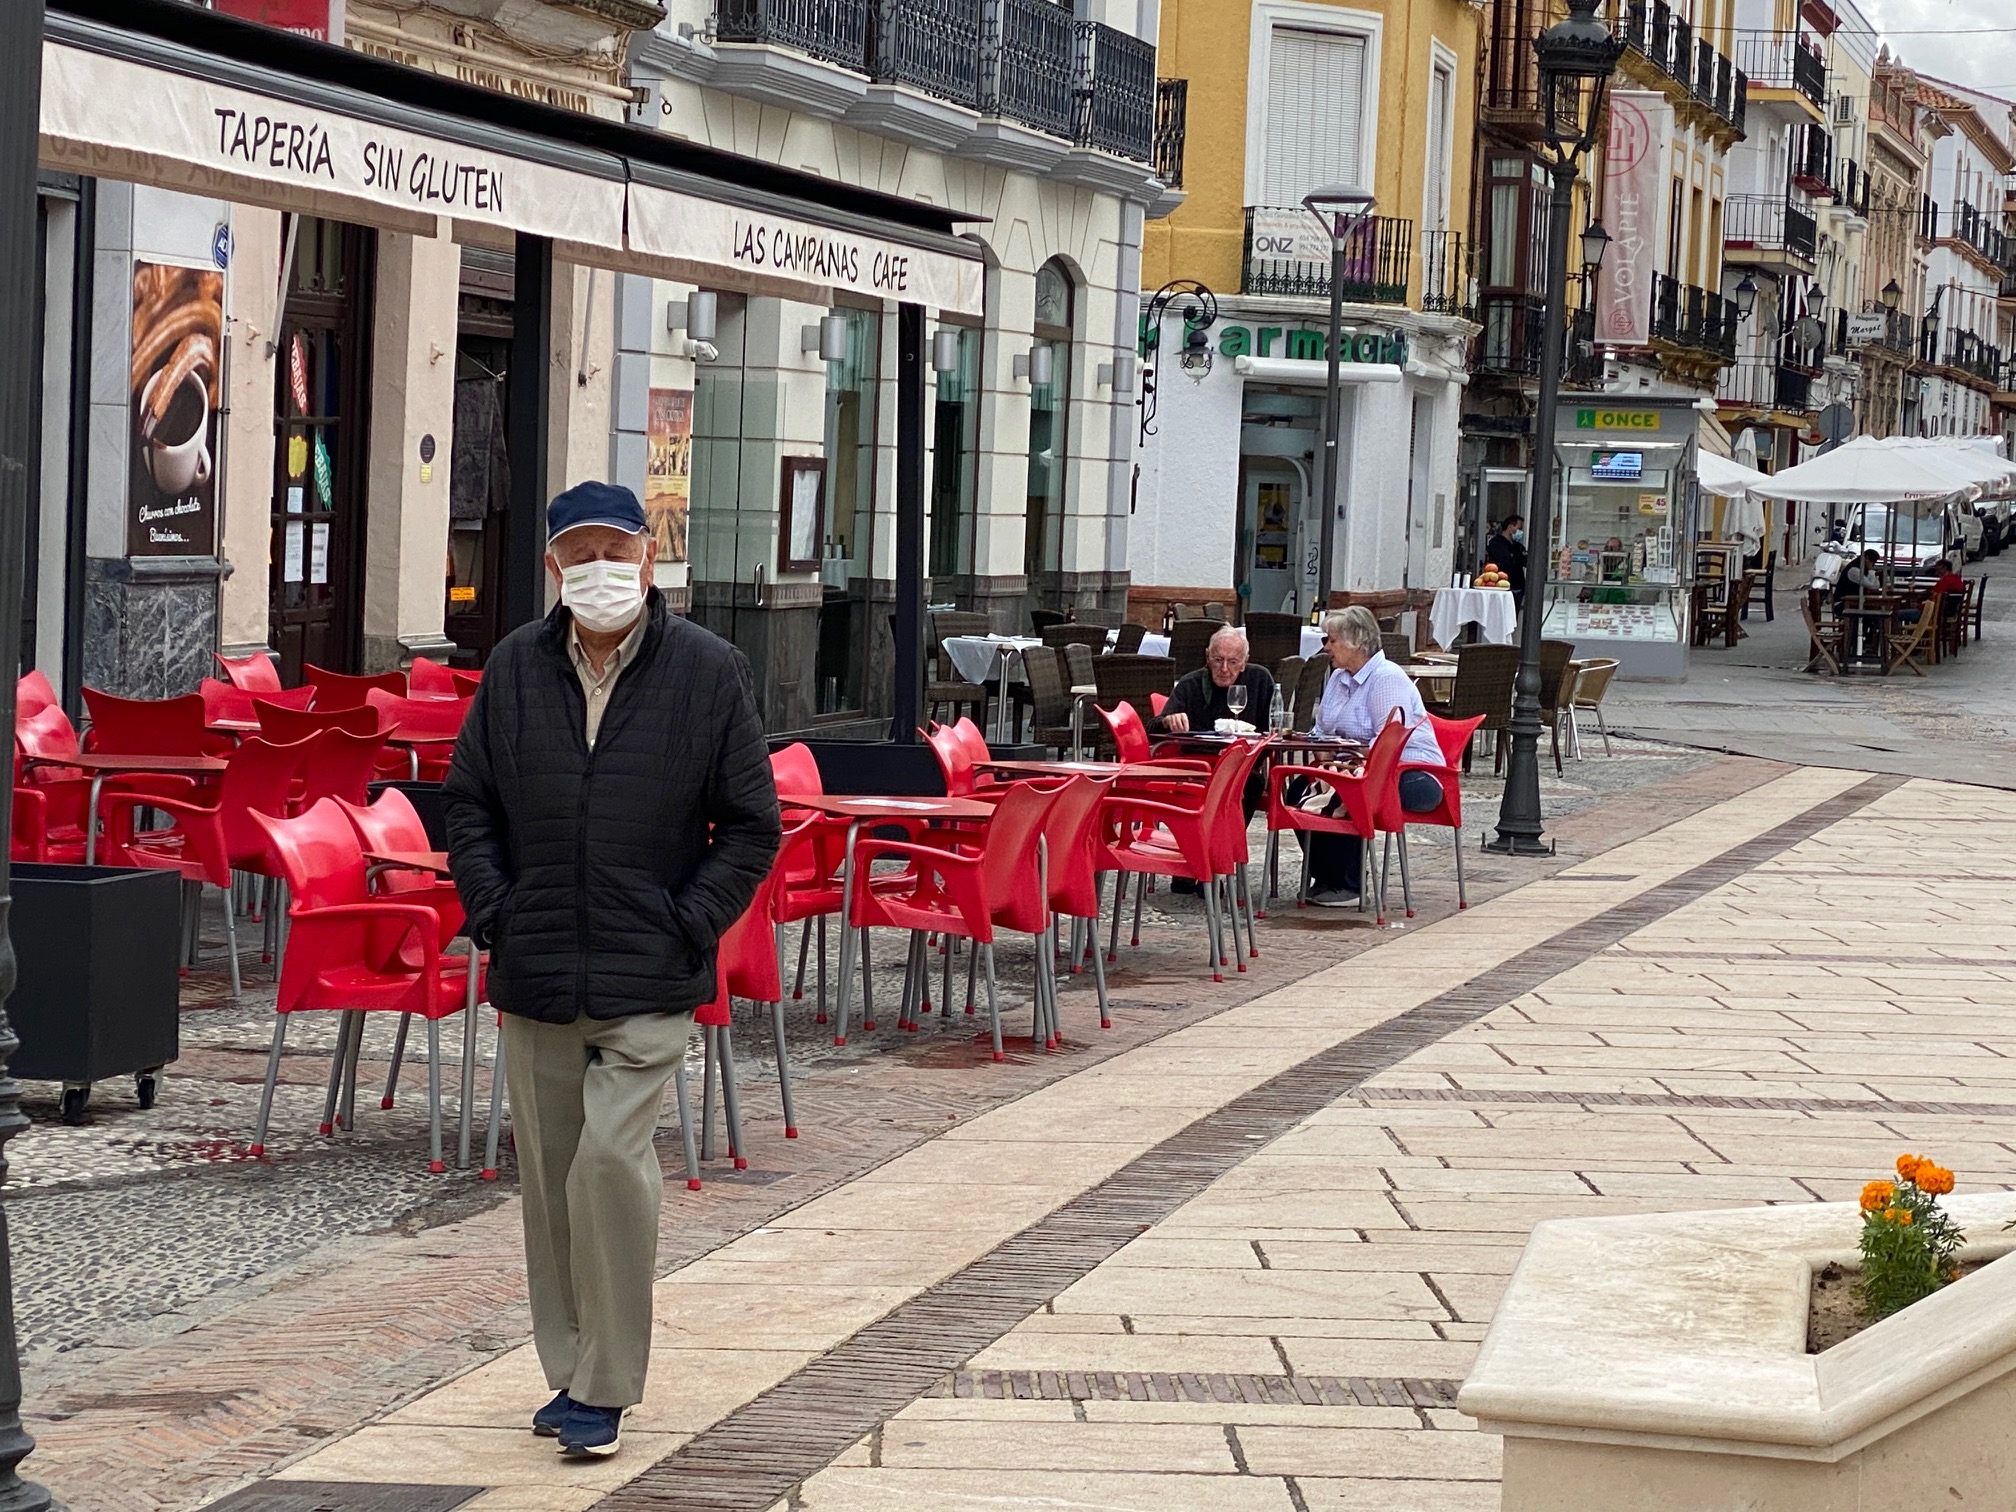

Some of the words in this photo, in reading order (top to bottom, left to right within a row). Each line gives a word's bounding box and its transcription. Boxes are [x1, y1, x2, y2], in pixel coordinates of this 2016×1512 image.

[214, 108, 335, 179] TAPERÍA
[363, 141, 402, 191] SIN
[409, 152, 503, 212] GLUTEN
[733, 221, 766, 264] LAS
[773, 228, 859, 283] CAMPANAS
[872, 251, 908, 291] CAFE
[1256, 236, 1294, 254] ONZ
[1614, 192, 1643, 305] VOLAPIÉ
[1602, 413, 1654, 427] ONCE
[164, 507, 175, 517] con
